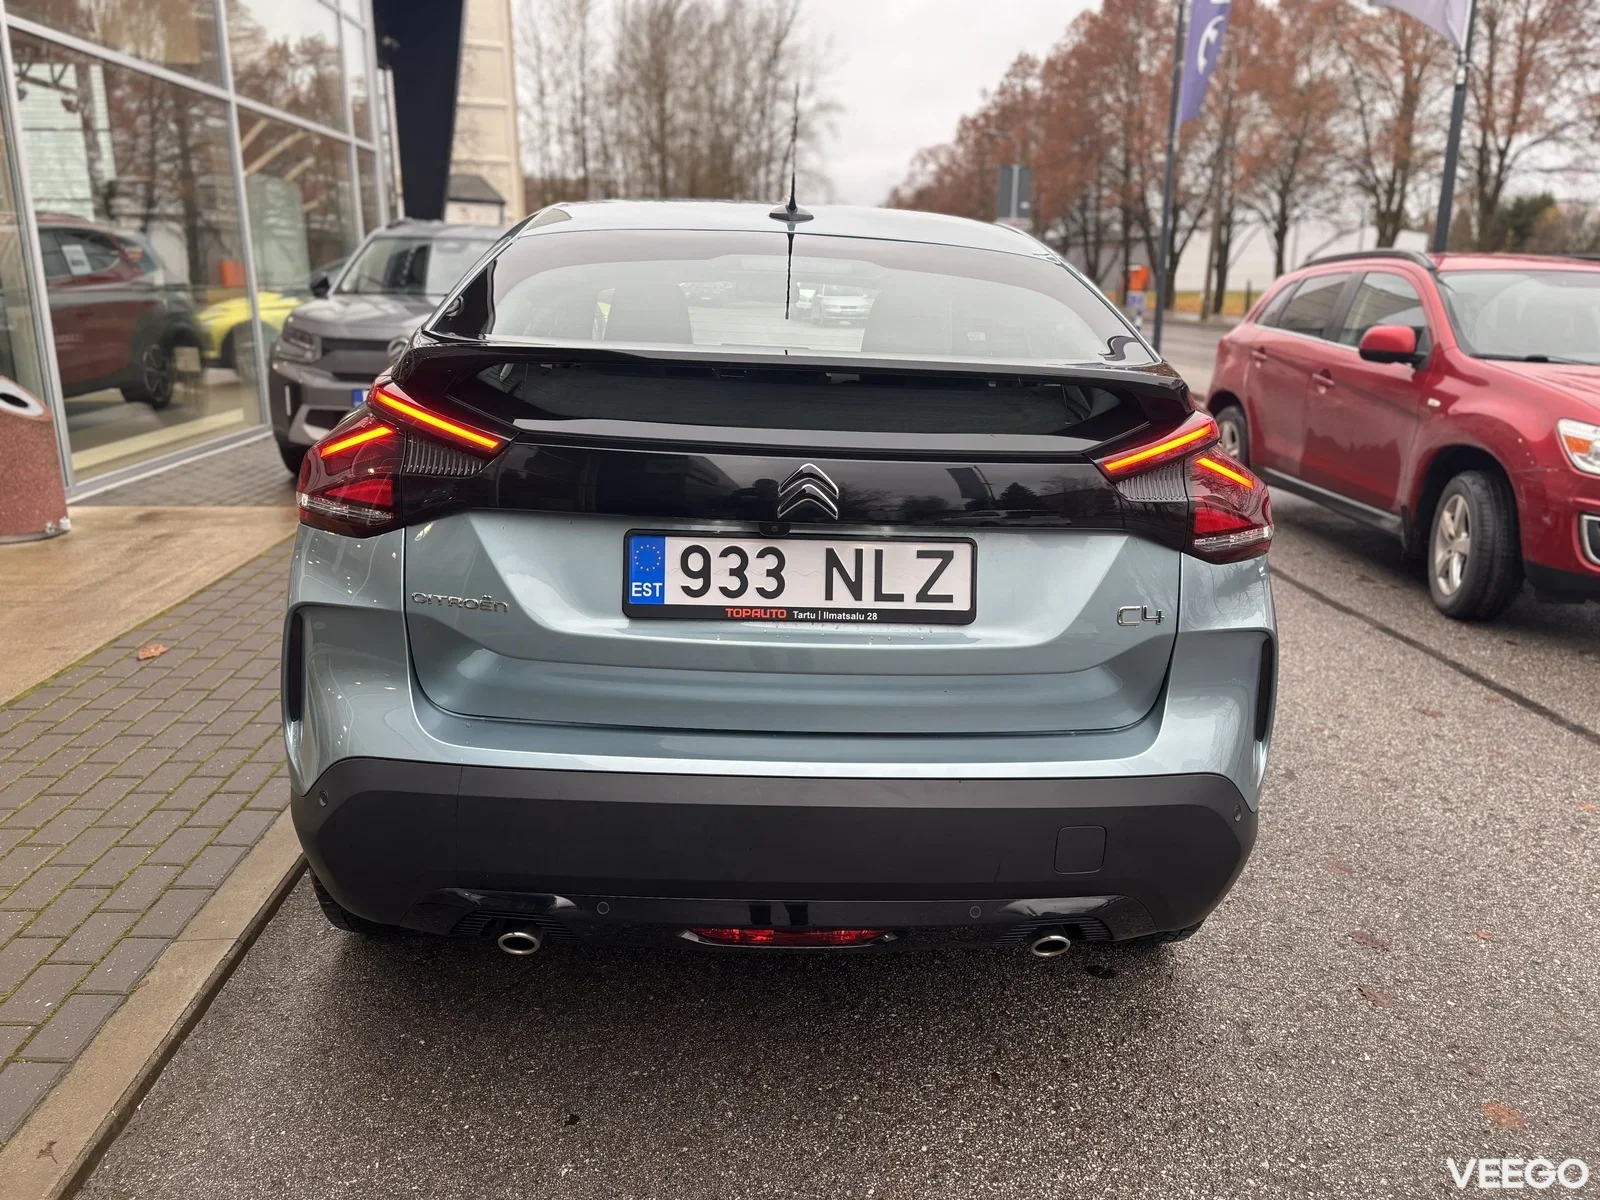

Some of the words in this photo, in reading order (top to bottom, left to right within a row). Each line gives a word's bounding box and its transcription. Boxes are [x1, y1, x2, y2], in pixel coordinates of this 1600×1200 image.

[680, 544, 786, 599] 933
[825, 547, 954, 603] NLZ
[631, 582, 663, 598] EST
[725, 608, 787, 618] TOPAUTO
[792, 610, 816, 619] Tartu
[823, 611, 865, 620] Ilmatsalu
[866, 612, 878, 620] 28
[1116, 605, 1166, 627] C4
